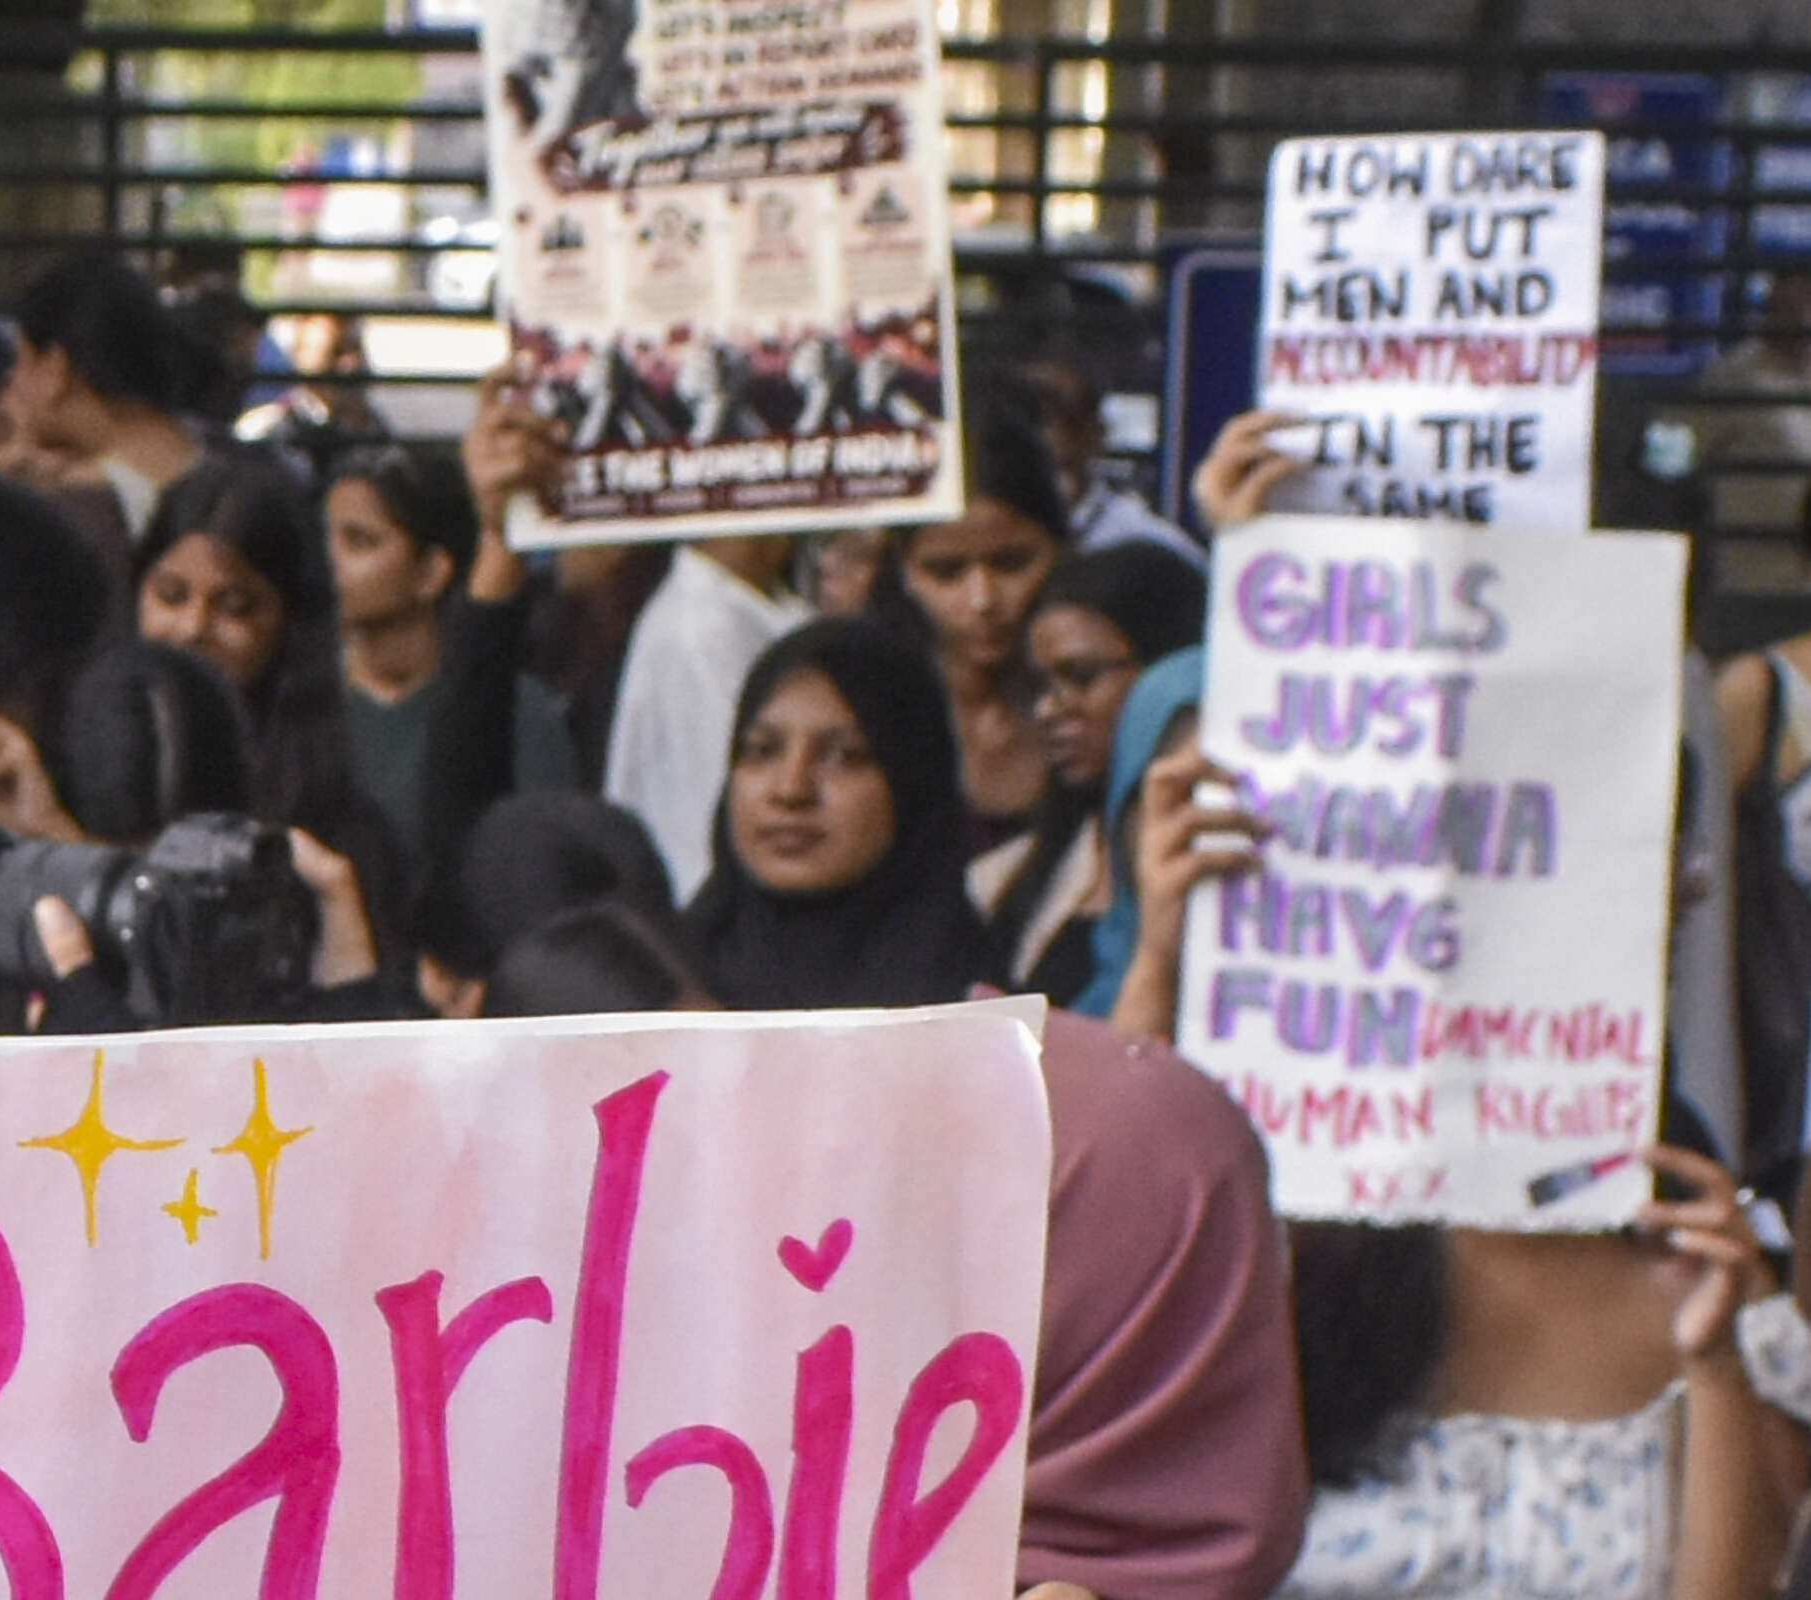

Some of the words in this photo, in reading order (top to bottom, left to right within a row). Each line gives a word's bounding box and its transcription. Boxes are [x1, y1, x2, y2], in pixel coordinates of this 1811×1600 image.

[1296, 147, 1427, 197] HOW
[1448, 139, 1580, 193] DARE
[1308, 207, 1353, 262] I
[1426, 206, 1553, 260] PUT
[1281, 268, 1408, 322] MEN
[1433, 268, 1553, 319] AND
[1308, 413, 1394, 467] IN
[1419, 413, 1539, 475] THE
[1235, 549, 1509, 653] GIRLS
[1240, 672, 1475, 760] JUST
